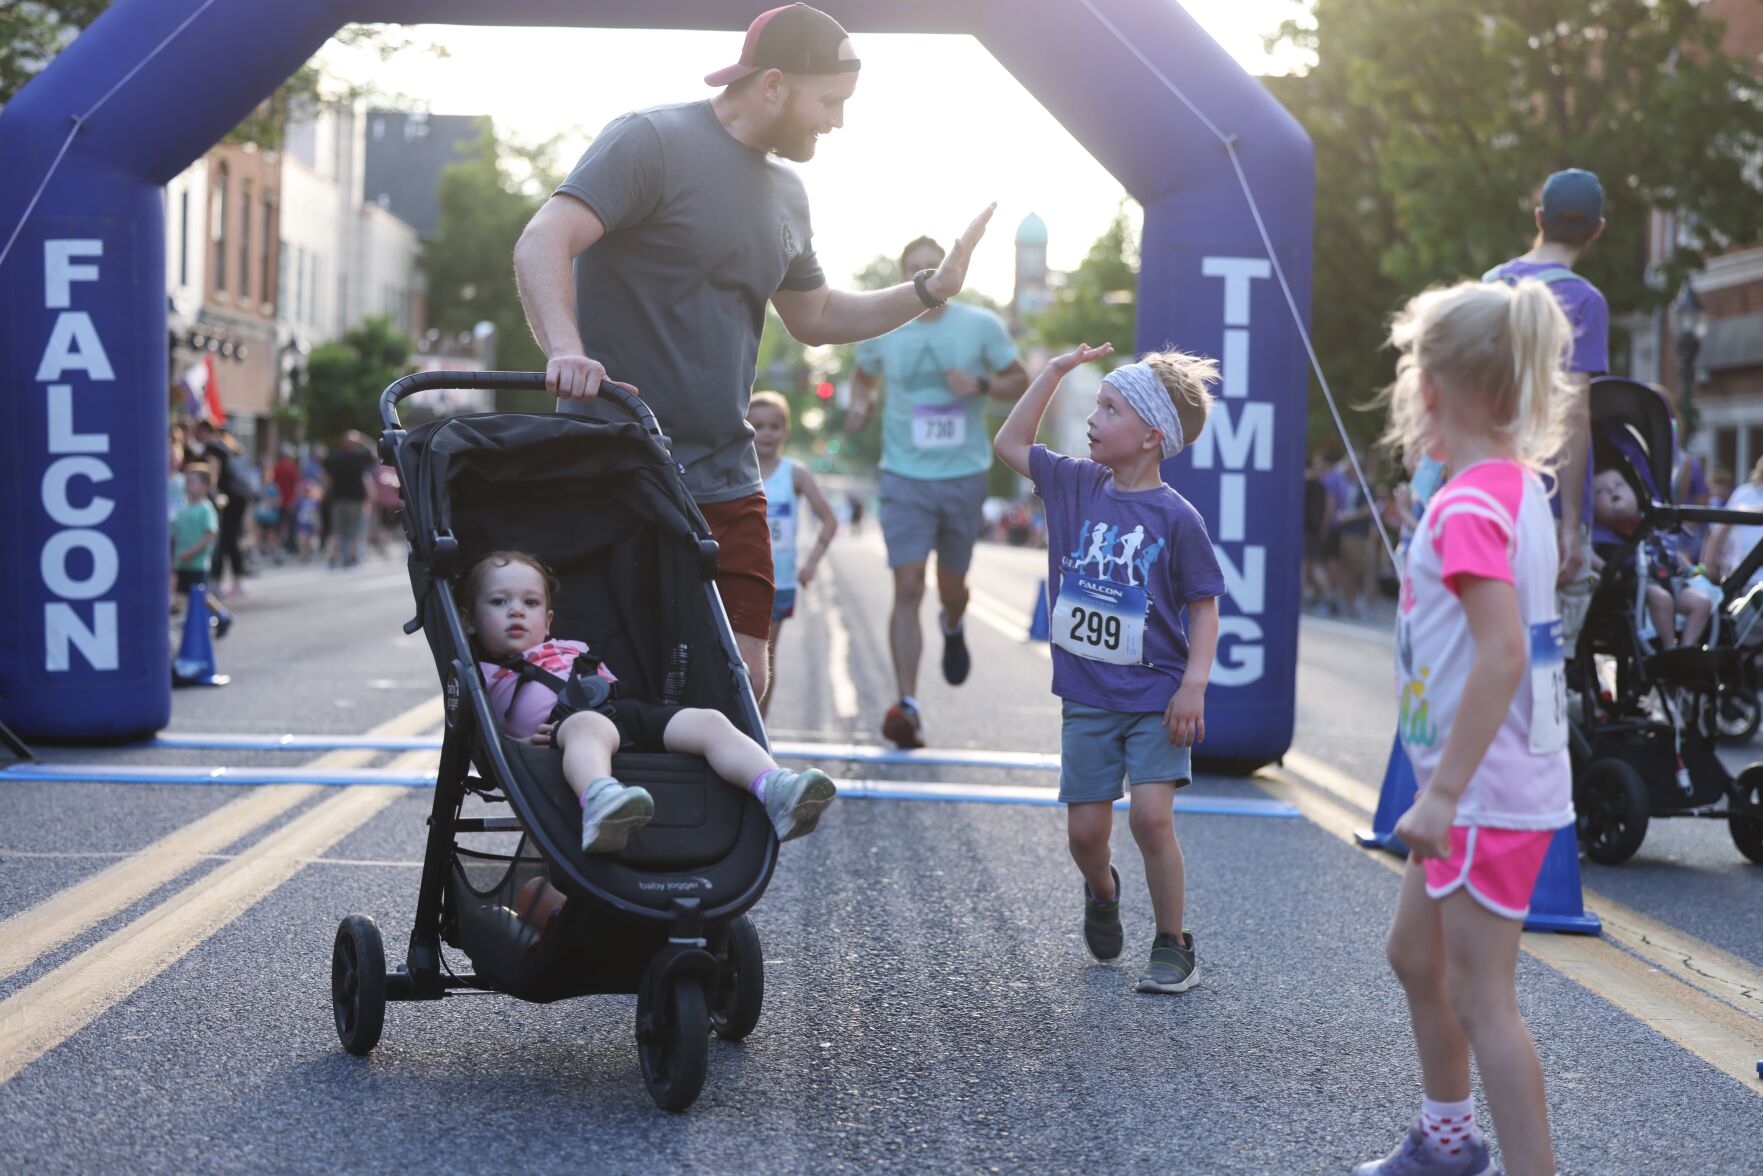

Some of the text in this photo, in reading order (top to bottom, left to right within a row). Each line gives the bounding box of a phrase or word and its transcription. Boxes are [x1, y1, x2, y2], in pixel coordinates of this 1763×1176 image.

[35, 239, 119, 672] FALCON
[1192, 256, 1275, 687] TIMING
[1078, 579, 1123, 597] FALCON
[1070, 606, 1121, 651] 299
[638, 881, 699, 891] baby jogger
